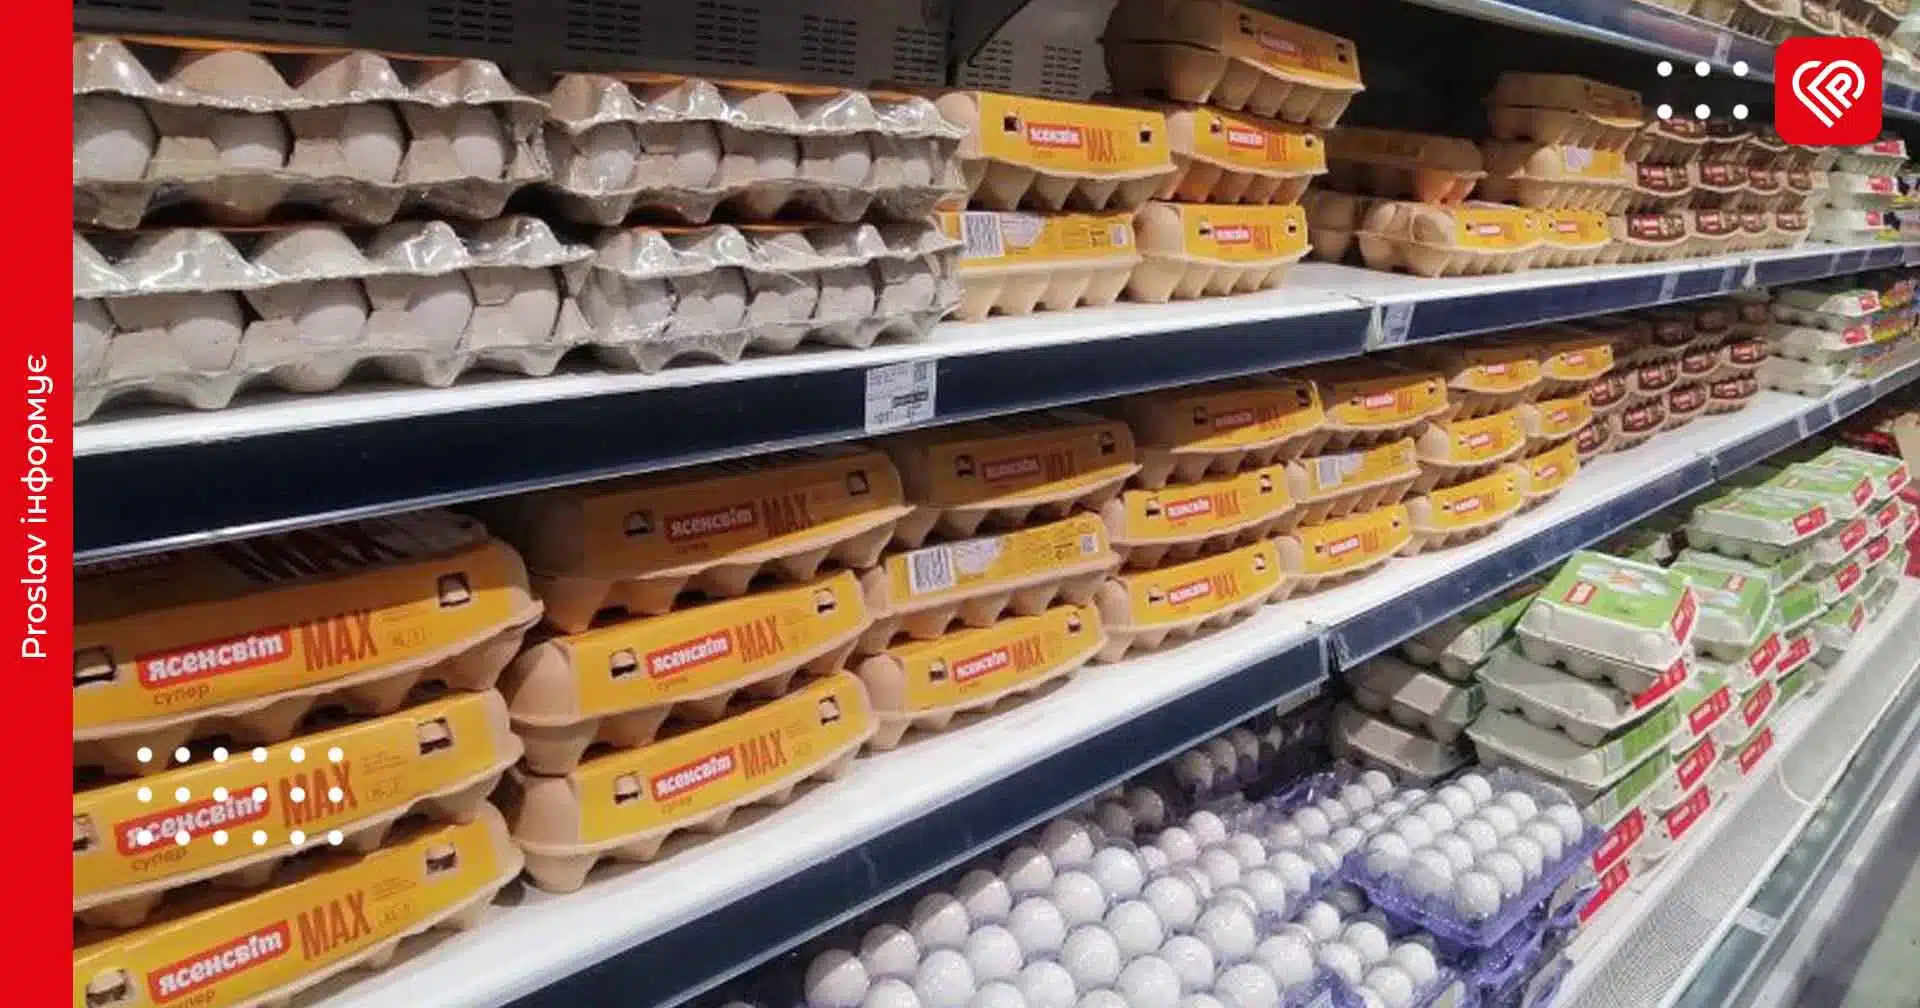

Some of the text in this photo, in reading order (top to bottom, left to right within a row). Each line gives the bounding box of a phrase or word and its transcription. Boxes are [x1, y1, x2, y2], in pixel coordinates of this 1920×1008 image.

[300, 608, 379, 672] MAX
[735, 615, 784, 664] MAX
[740, 728, 788, 780] MAX
[297, 889, 372, 961] MAX
